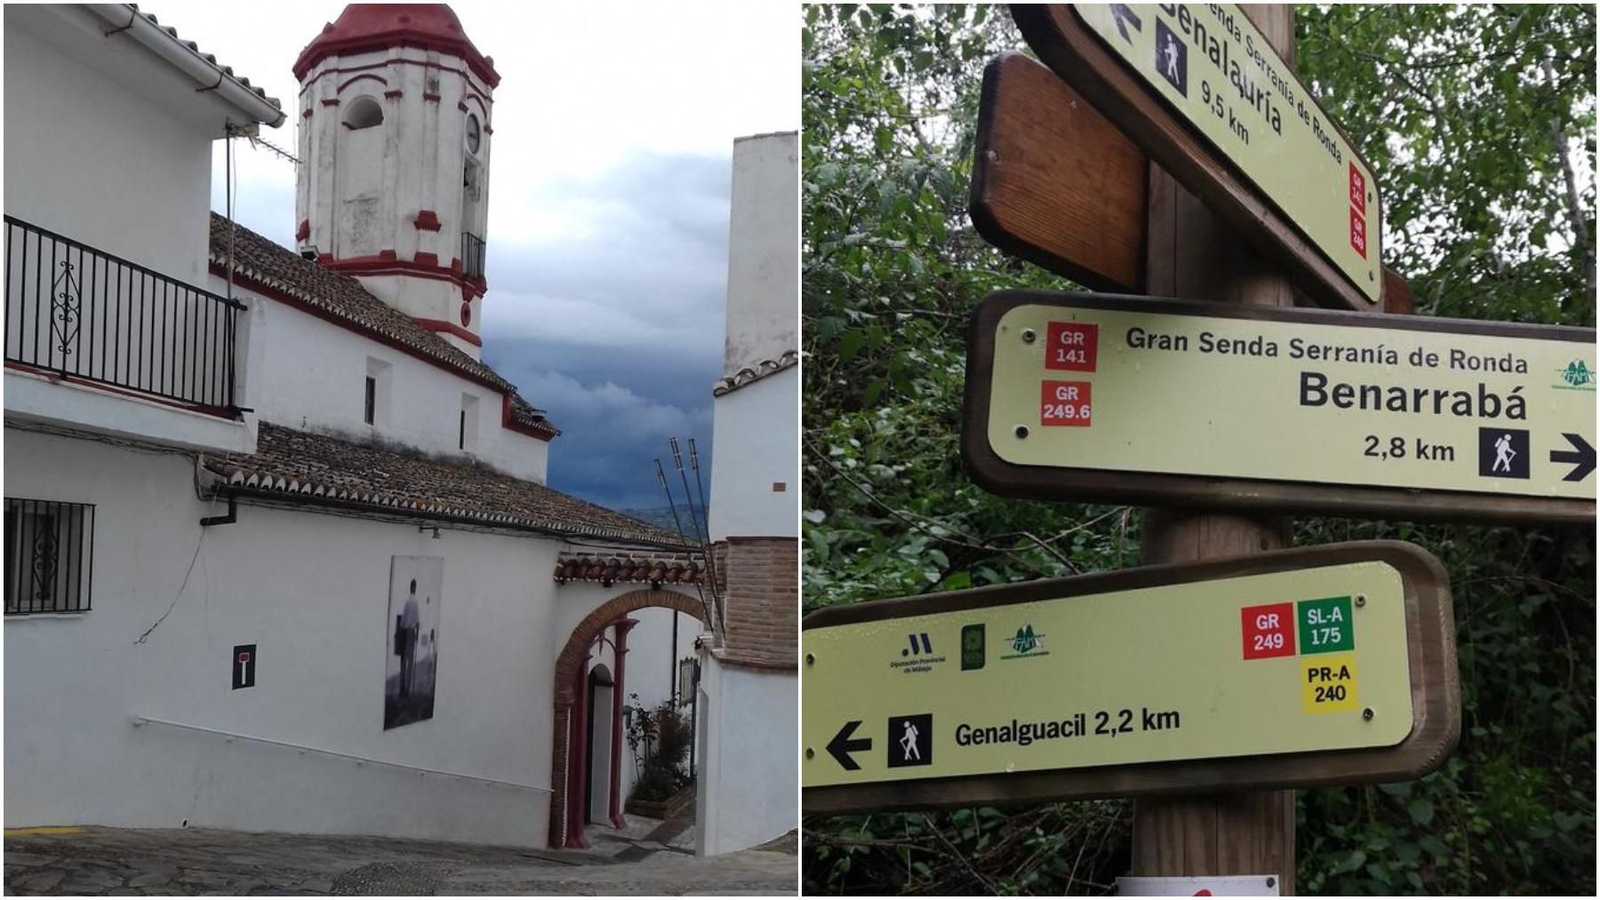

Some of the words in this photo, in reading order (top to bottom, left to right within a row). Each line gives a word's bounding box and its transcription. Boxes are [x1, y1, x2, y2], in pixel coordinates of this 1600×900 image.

[1204, 4, 1241, 44] enda
[1246, 34, 1294, 108] Serranía
[1296, 94, 1310, 126] de
[1313, 116, 1342, 165] Ronda
[1201, 79, 1225, 119] 9,5
[1229, 105, 1249, 146] km
[1060, 331, 1085, 346] GR
[1056, 348, 1087, 364] 141
[1126, 327, 1188, 351] Gran
[1199, 332, 1278, 358] Senda
[1289, 338, 1398, 365] Serranía
[1409, 347, 1439, 368] de
[1450, 349, 1528, 374] Ronda
[1055, 386, 1079, 400] GR
[1299, 371, 1527, 420] Benarrabá
[1043, 404, 1091, 419] 249.6
[1364, 434, 1406, 461] 2,8
[1416, 438, 1454, 461] km
[1256, 613, 1279, 630] GR
[1307, 606, 1343, 625] SL-A
[1254, 633, 1284, 651] 249
[1311, 627, 1342, 645] 175
[1308, 665, 1351, 683] PR-A
[1315, 685, 1346, 703] 240
[955, 713, 1086, 746] Genalguacil
[1094, 708, 1134, 738] 2,2
[1142, 707, 1180, 731] km
